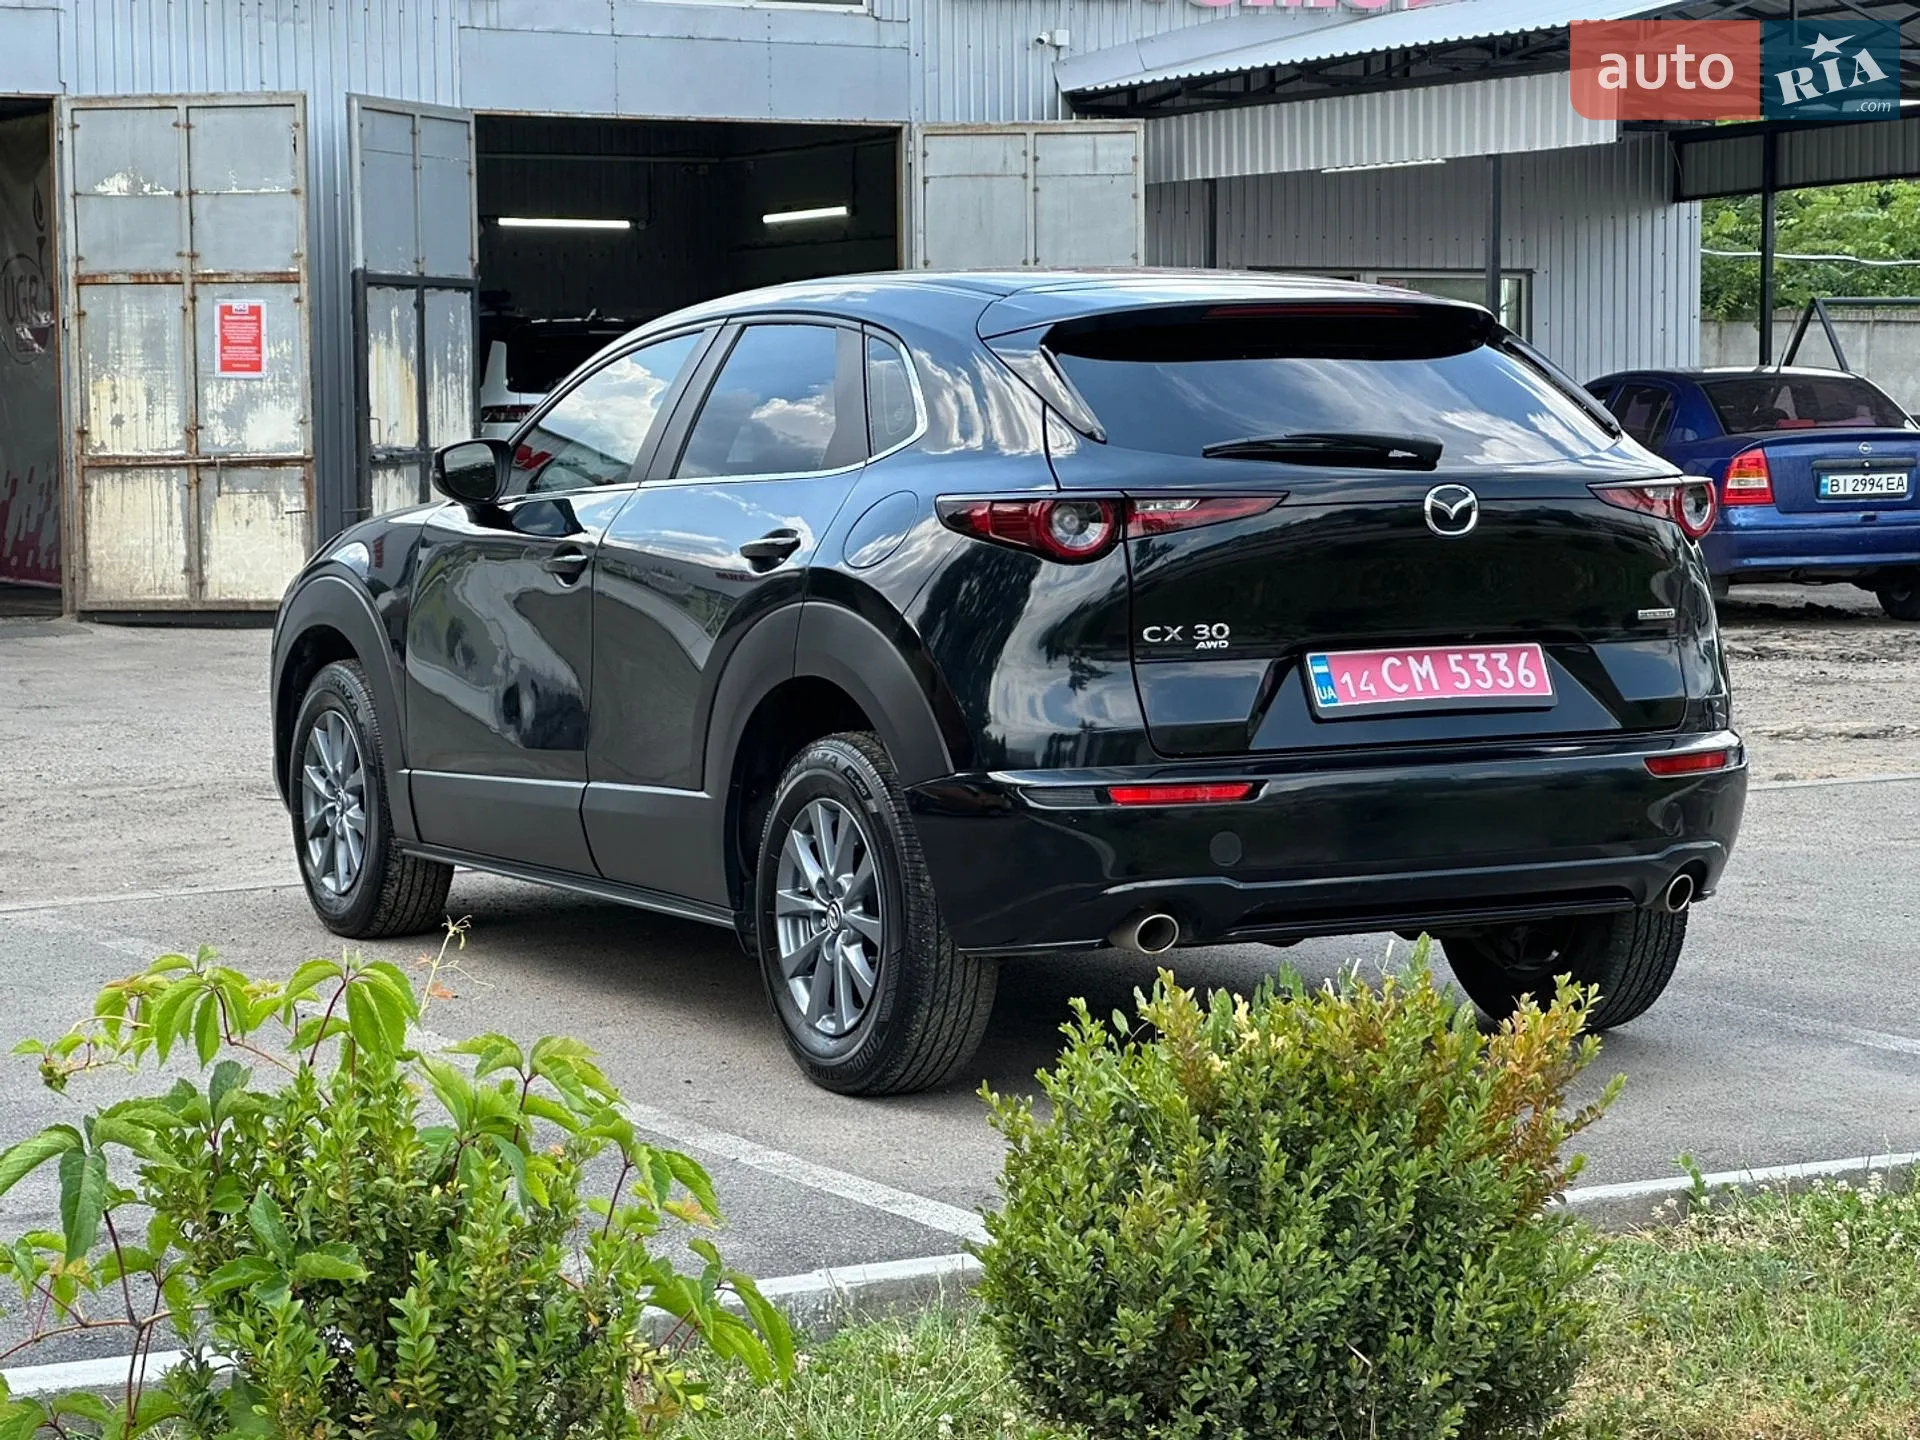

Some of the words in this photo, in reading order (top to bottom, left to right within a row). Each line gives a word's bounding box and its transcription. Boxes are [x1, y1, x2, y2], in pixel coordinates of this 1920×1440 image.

[1851, 477, 1884, 492] 2994
[1886, 476, 1905, 491] EA
[1142, 625, 1184, 643] CX
[1192, 622, 1231, 640] 30
[1195, 640, 1229, 650] AWD
[1340, 670, 1377, 698] 14
[1381, 654, 1440, 694] CM
[1448, 651, 1537, 690] 5336
[1318, 685, 1337, 700] UA
